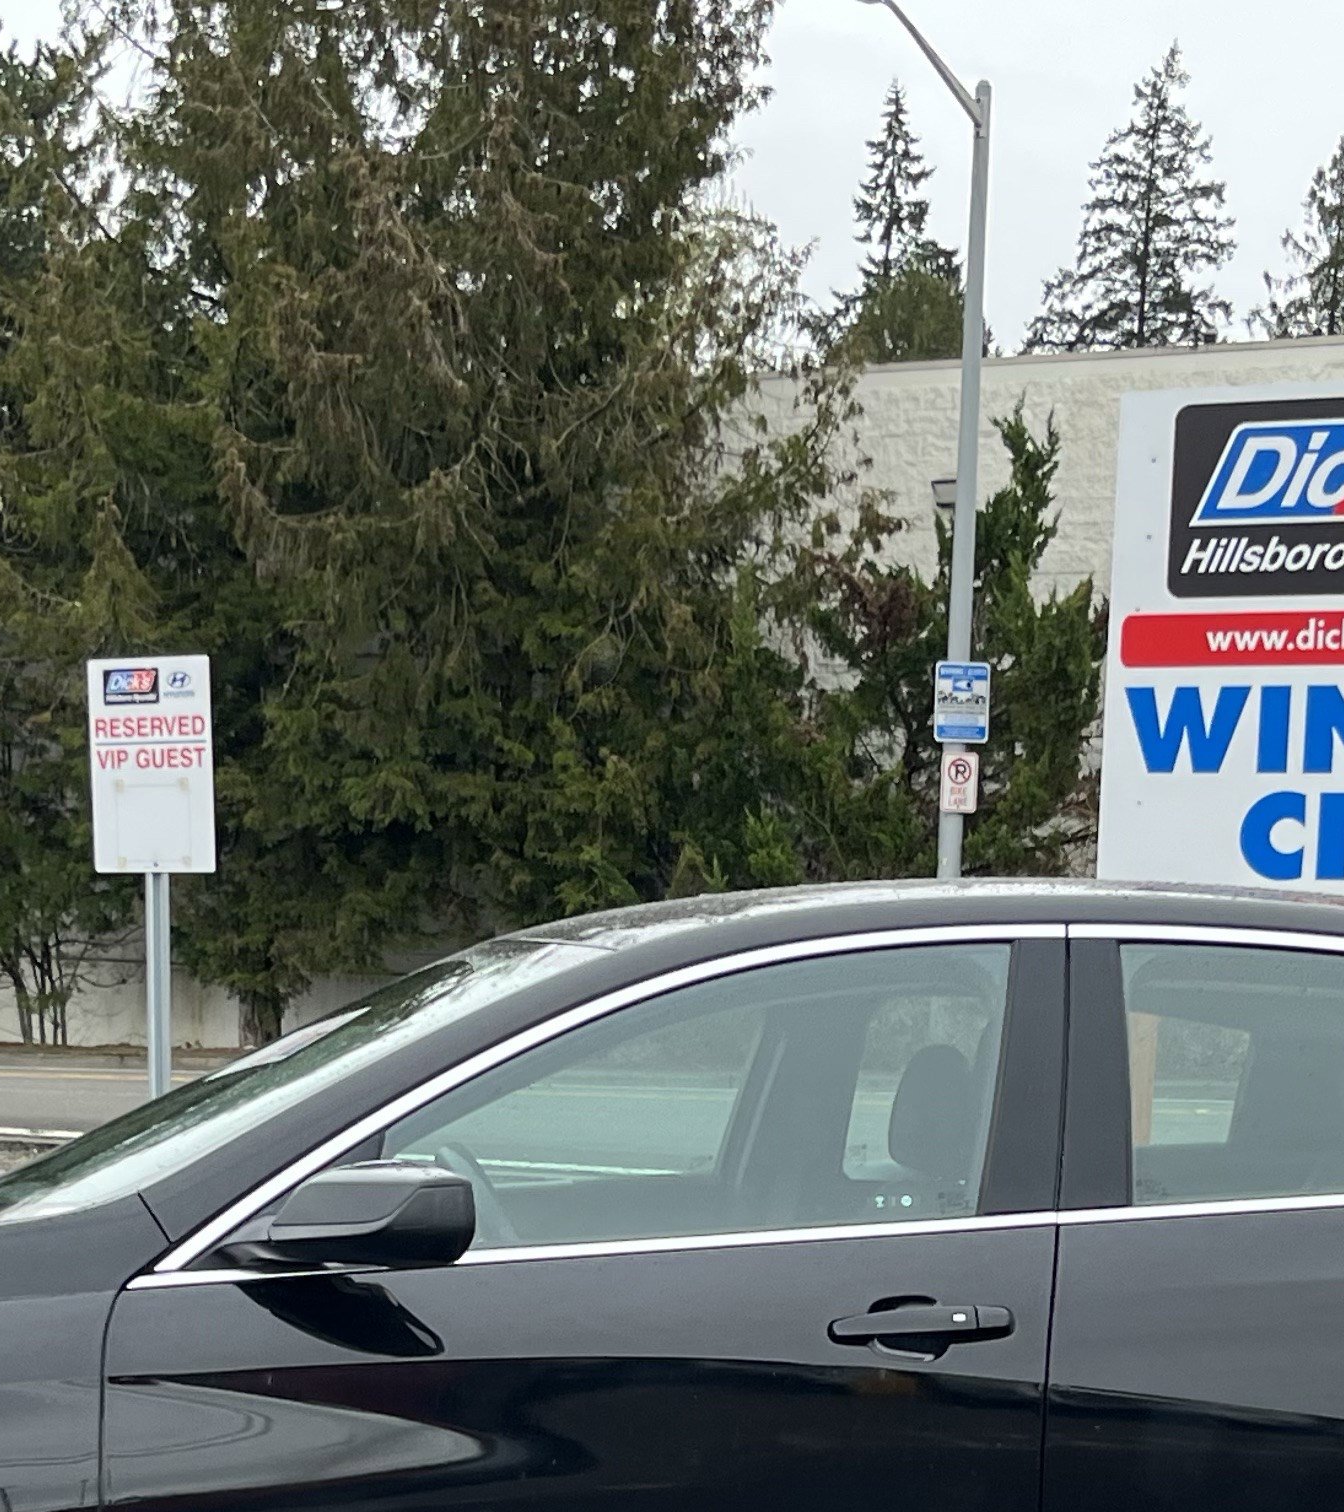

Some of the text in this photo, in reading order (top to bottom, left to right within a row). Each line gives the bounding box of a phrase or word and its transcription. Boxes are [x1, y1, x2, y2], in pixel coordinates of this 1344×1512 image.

[94, 715, 205, 739] RESERVED
[96, 747, 205, 770] VIP GUEST
